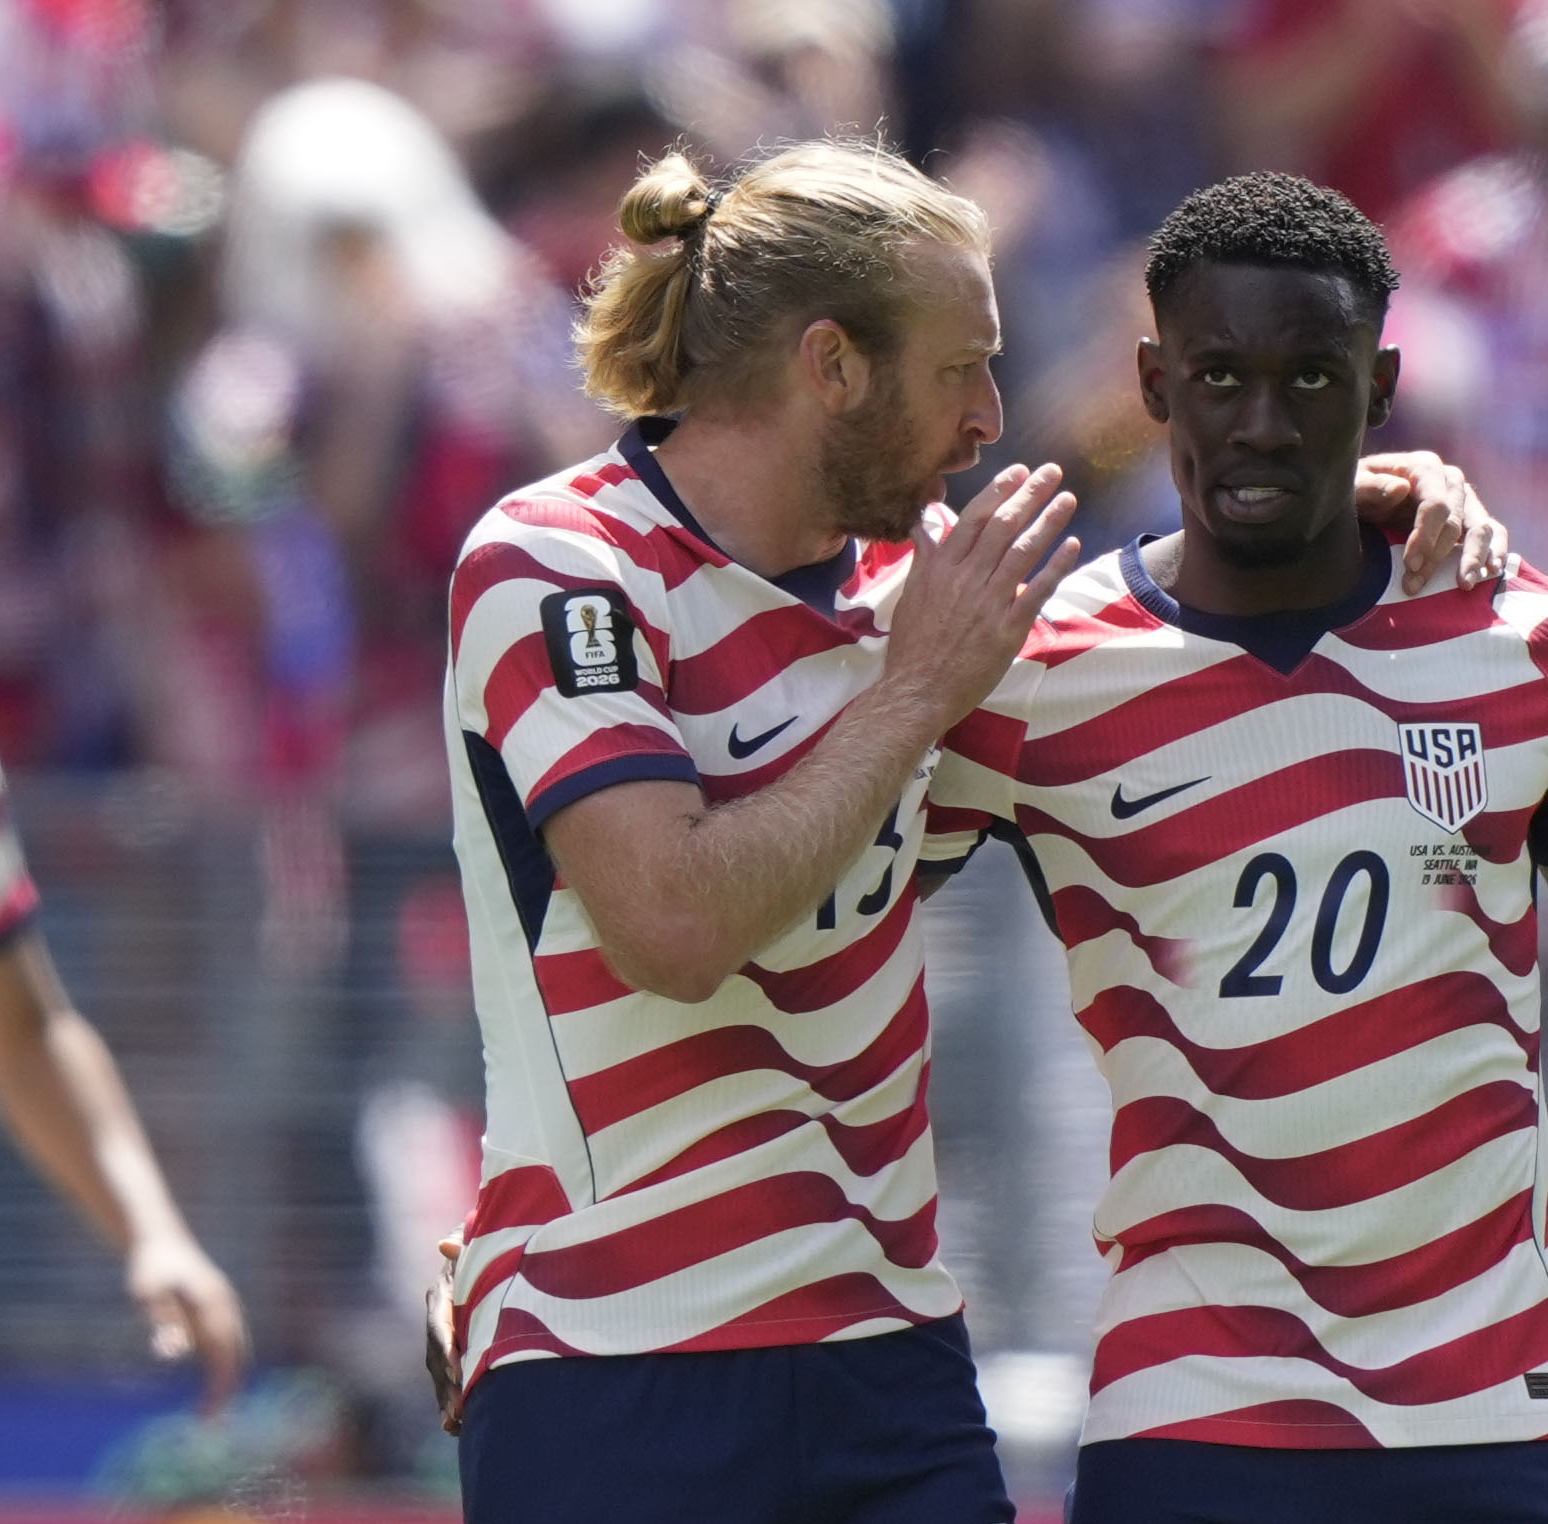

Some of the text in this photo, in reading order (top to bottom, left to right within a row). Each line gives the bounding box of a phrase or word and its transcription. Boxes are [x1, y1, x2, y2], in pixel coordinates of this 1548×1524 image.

[585, 651, 605, 659] FIFA
[574, 665, 619, 676] WORLD CUP
[576, 673, 620, 687] 2026
[1405, 728, 1477, 768] USA
[1410, 845, 1428, 856] USA
[1449, 845, 1491, 857] AUSTR
[1218, 850, 1390, 998] 20
